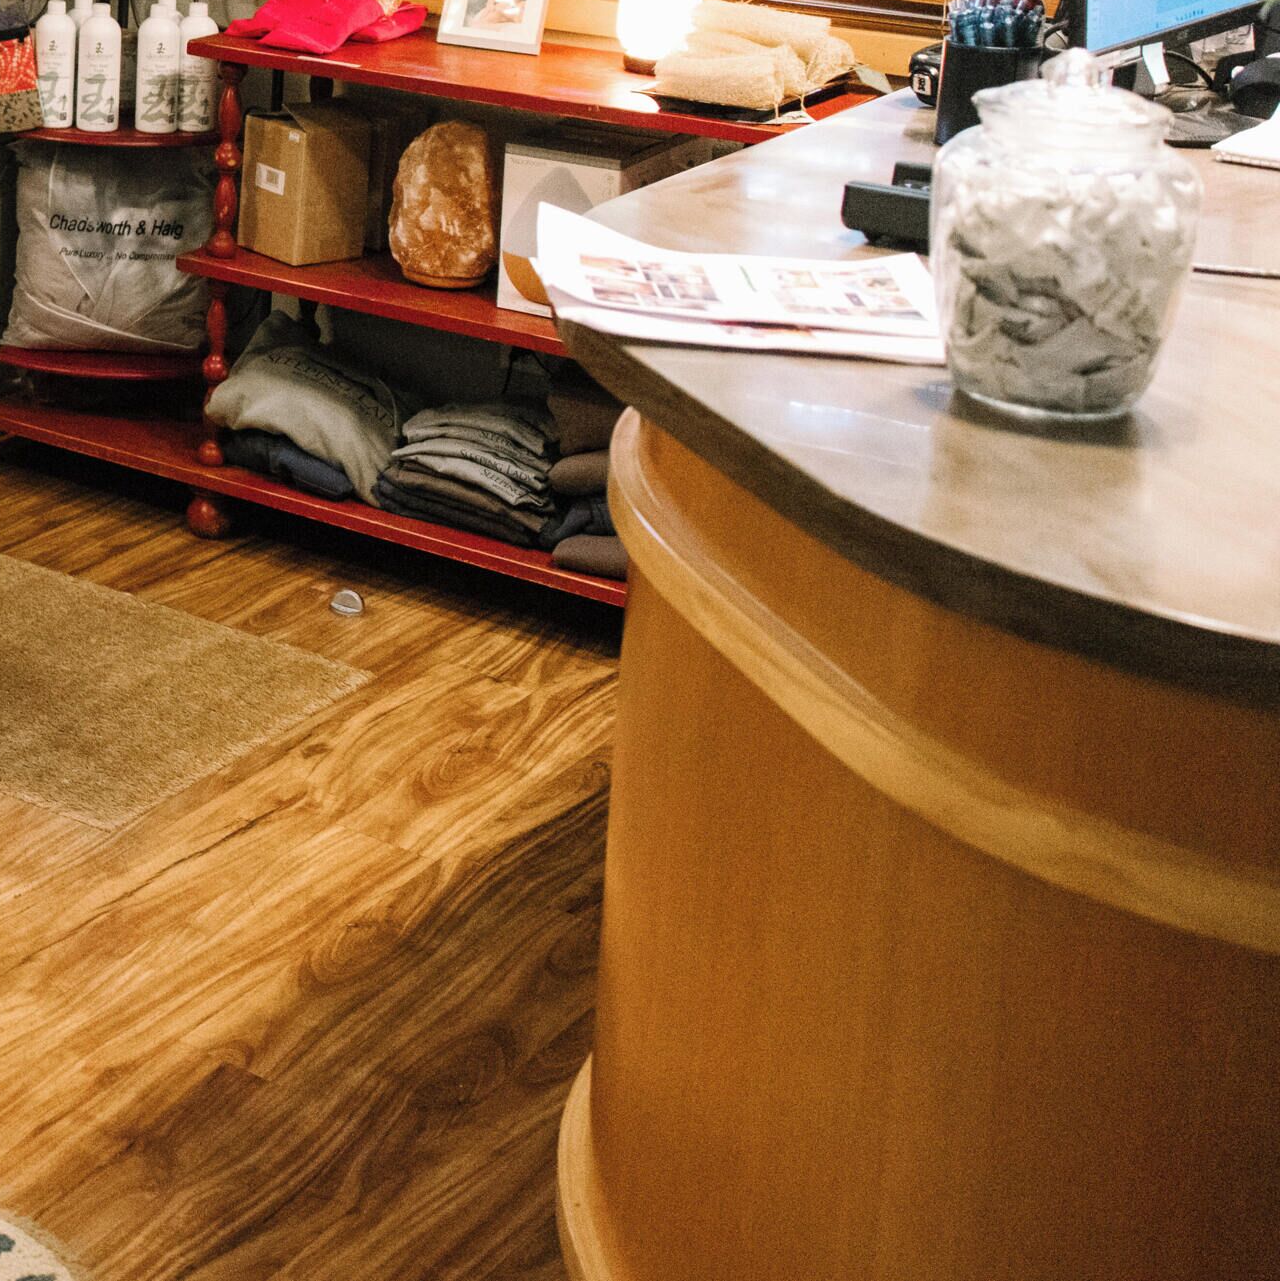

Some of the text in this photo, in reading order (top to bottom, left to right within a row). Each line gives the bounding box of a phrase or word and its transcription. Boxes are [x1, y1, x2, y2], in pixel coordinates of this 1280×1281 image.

[49, 213, 184, 240] Chadsworth & Haig
[59, 247, 78, 257] Pure
[79, 249, 104, 262] Luxury
[115, 252, 127, 260] No
